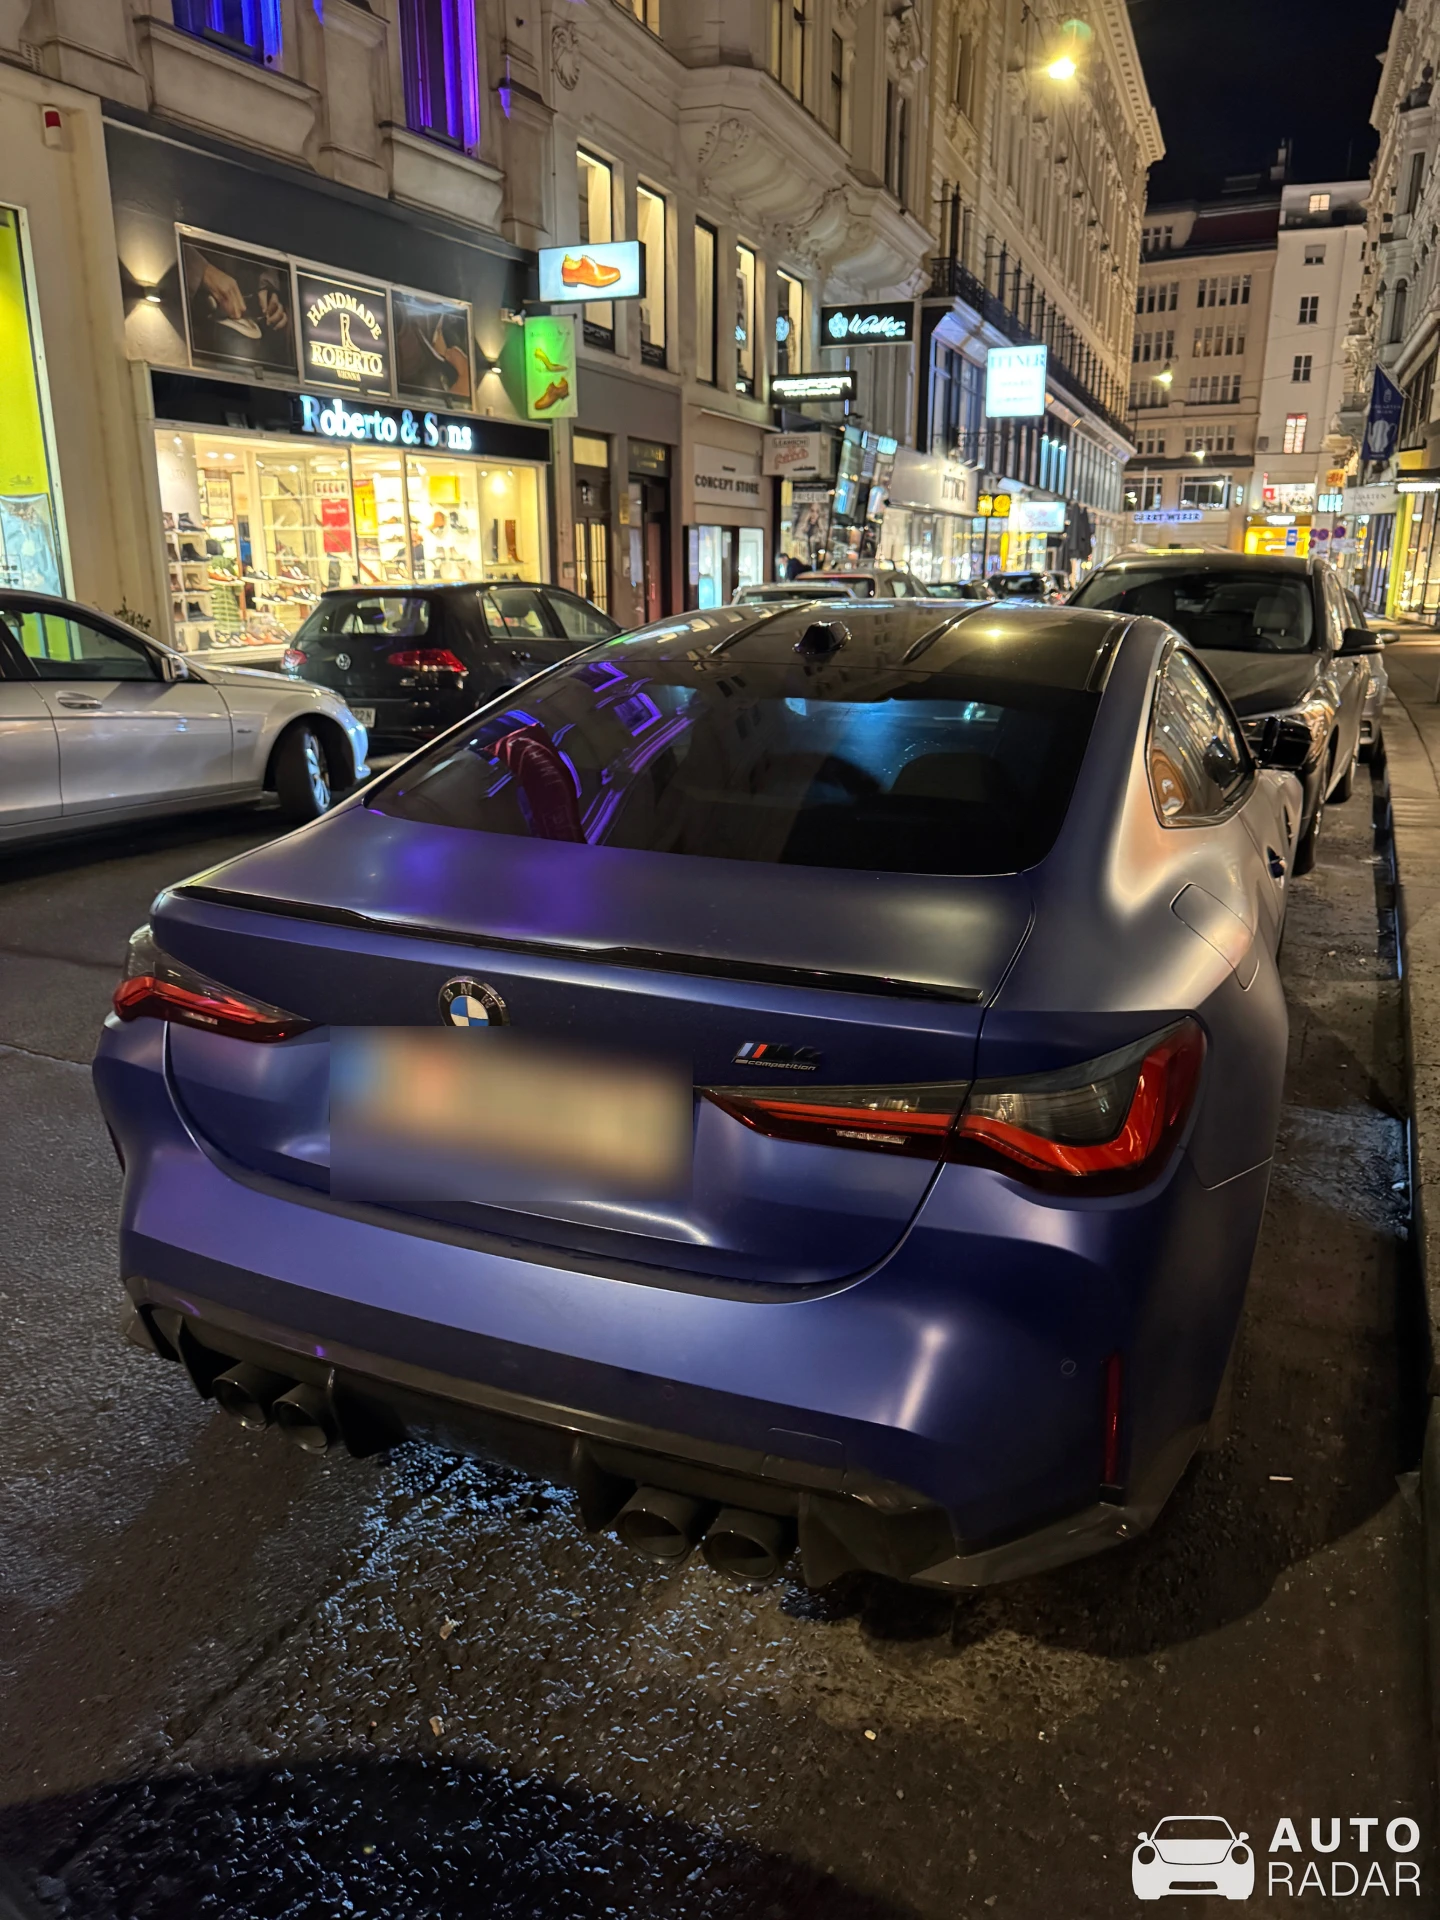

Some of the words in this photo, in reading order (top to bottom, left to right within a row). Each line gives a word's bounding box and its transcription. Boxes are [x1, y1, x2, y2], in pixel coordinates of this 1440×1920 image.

[306, 291, 382, 340] HANDMADE
[311, 344, 383, 374] ROBERTO
[300, 395, 398, 442] Roberto
[401, 409, 421, 444] &
[424, 411, 472, 450] Sons
[694, 474, 734, 491] CONCEPT
[735, 480, 760, 495] STORE
[443, 982, 497, 1009] BMW
[748, 1059, 817, 1071] competition
